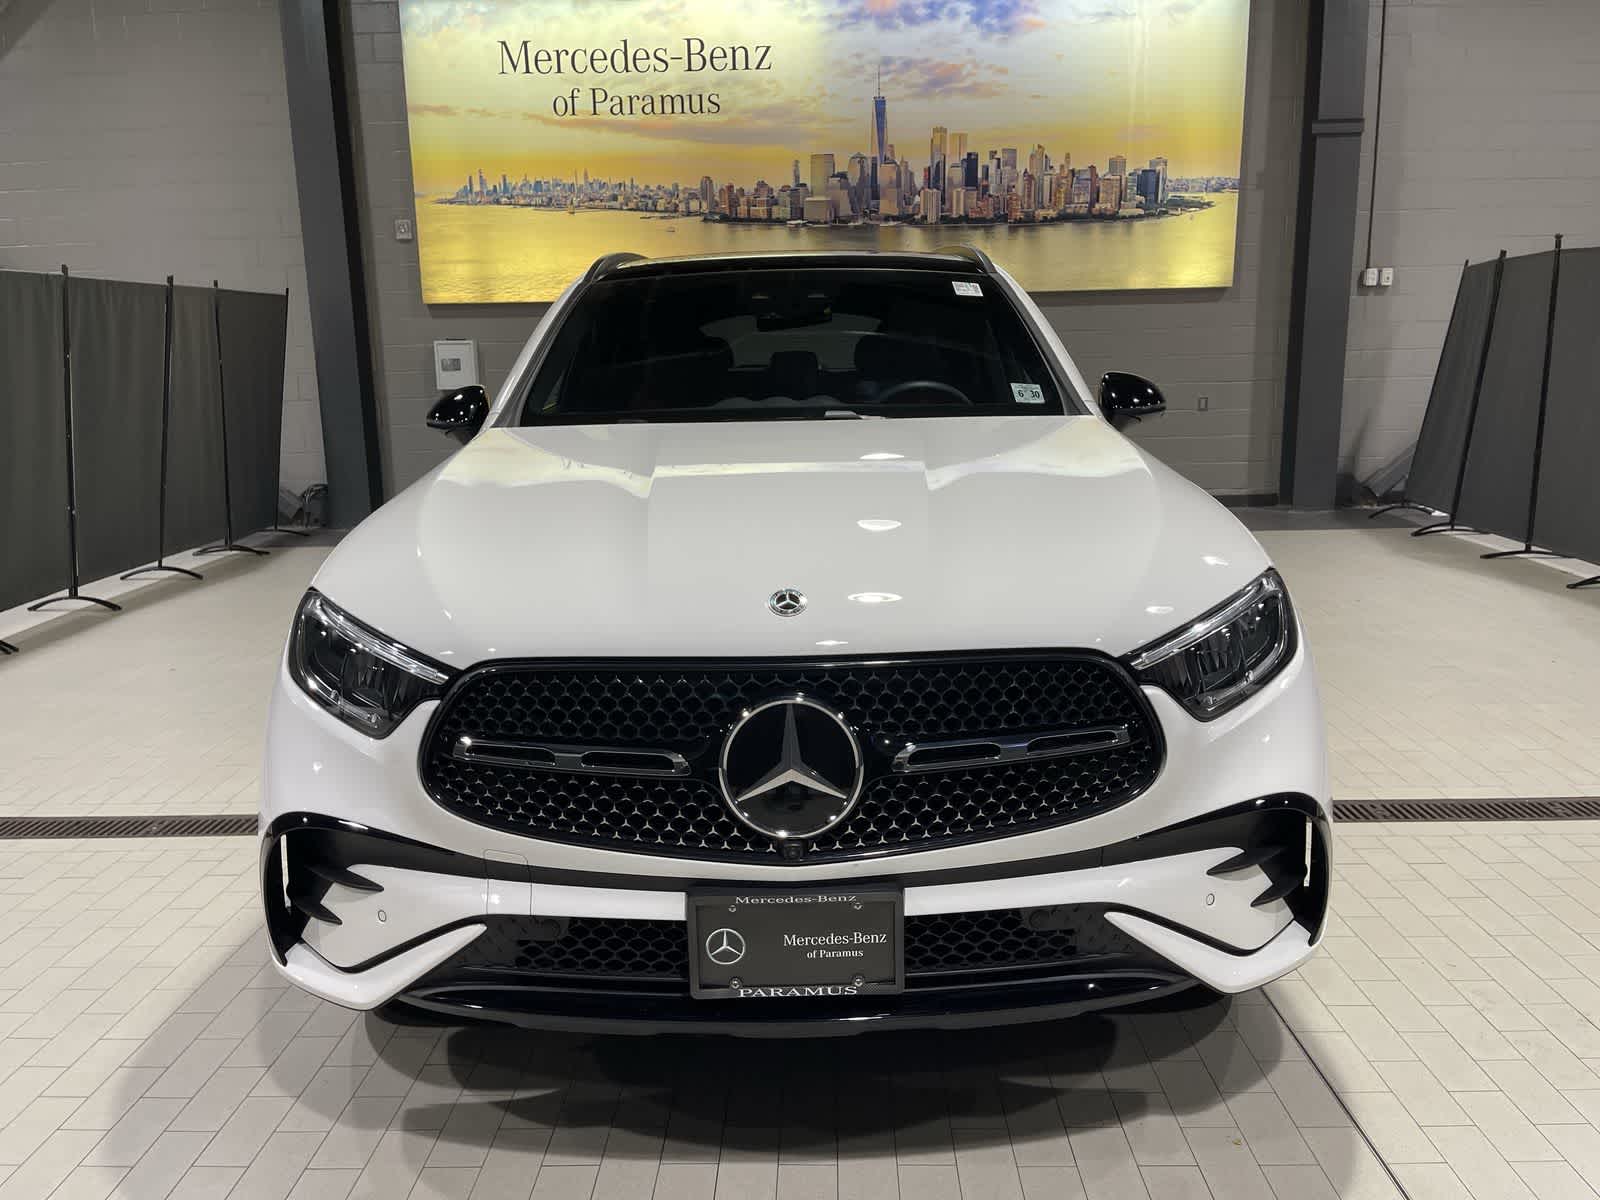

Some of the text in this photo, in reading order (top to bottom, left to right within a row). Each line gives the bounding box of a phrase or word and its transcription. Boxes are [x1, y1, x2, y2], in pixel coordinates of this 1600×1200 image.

[497, 37, 773, 75] Mercedes-Benz
[552, 87, 721, 116] of Paramus
[735, 895, 857, 904] Mercedes-Benz
[783, 932, 887, 946] Mercedes-Benz
[807, 949, 864, 958] of Paramus
[739, 986, 858, 997] PARAMUS
